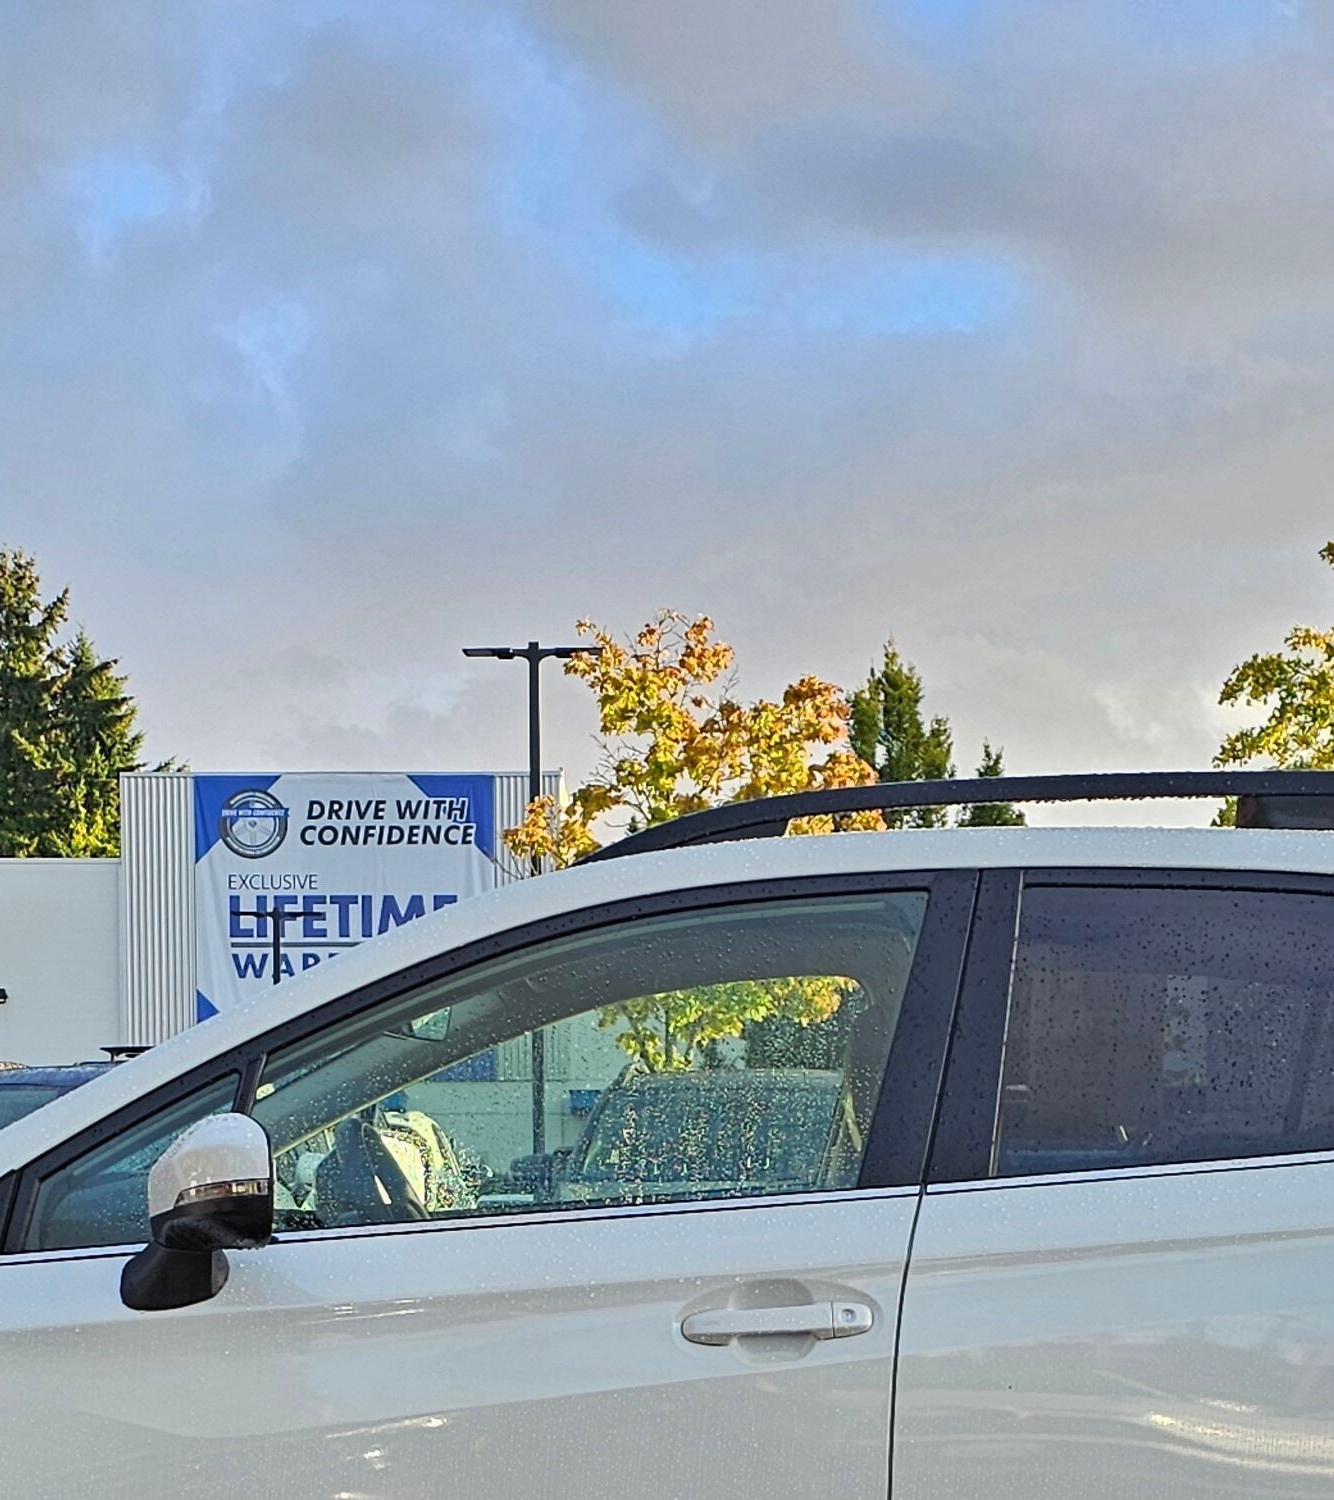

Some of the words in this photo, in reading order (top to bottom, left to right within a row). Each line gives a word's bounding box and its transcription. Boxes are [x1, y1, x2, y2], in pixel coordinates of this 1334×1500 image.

[306, 799, 387, 820] DRIVE
[395, 799, 467, 820] WITH
[299, 825, 475, 846] CONFIDENCE
[228, 874, 319, 890] EXCLUSIVE
